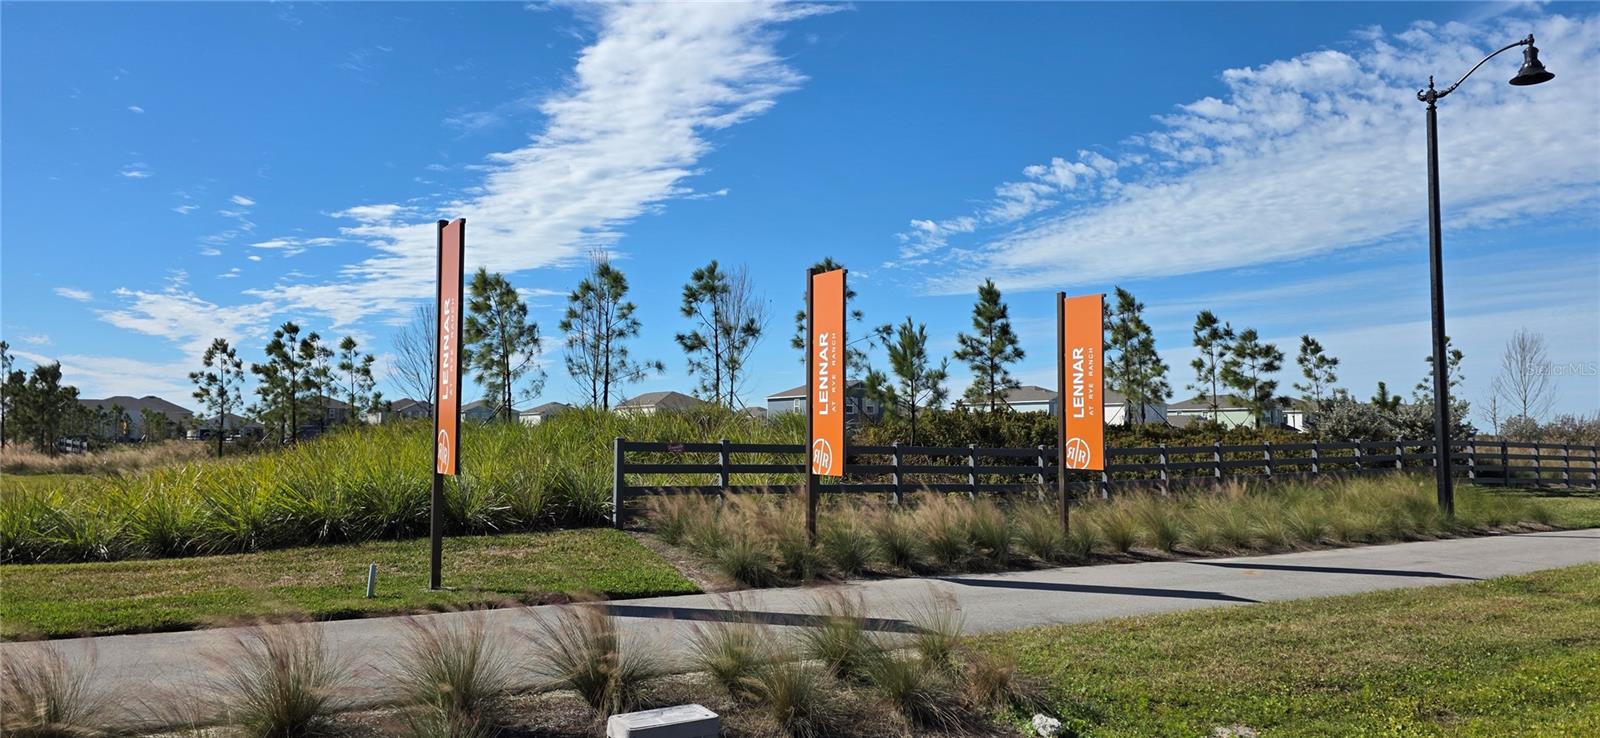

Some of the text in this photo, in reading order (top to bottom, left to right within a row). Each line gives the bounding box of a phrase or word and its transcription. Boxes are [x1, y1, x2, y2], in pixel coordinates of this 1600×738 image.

[442, 298, 451, 400] LENNAR
[819, 332, 829, 416] LENNAR
[1072, 347, 1085, 418] LENNAR
[832, 401, 837, 413] AT
[1088, 406, 1094, 416] AT
